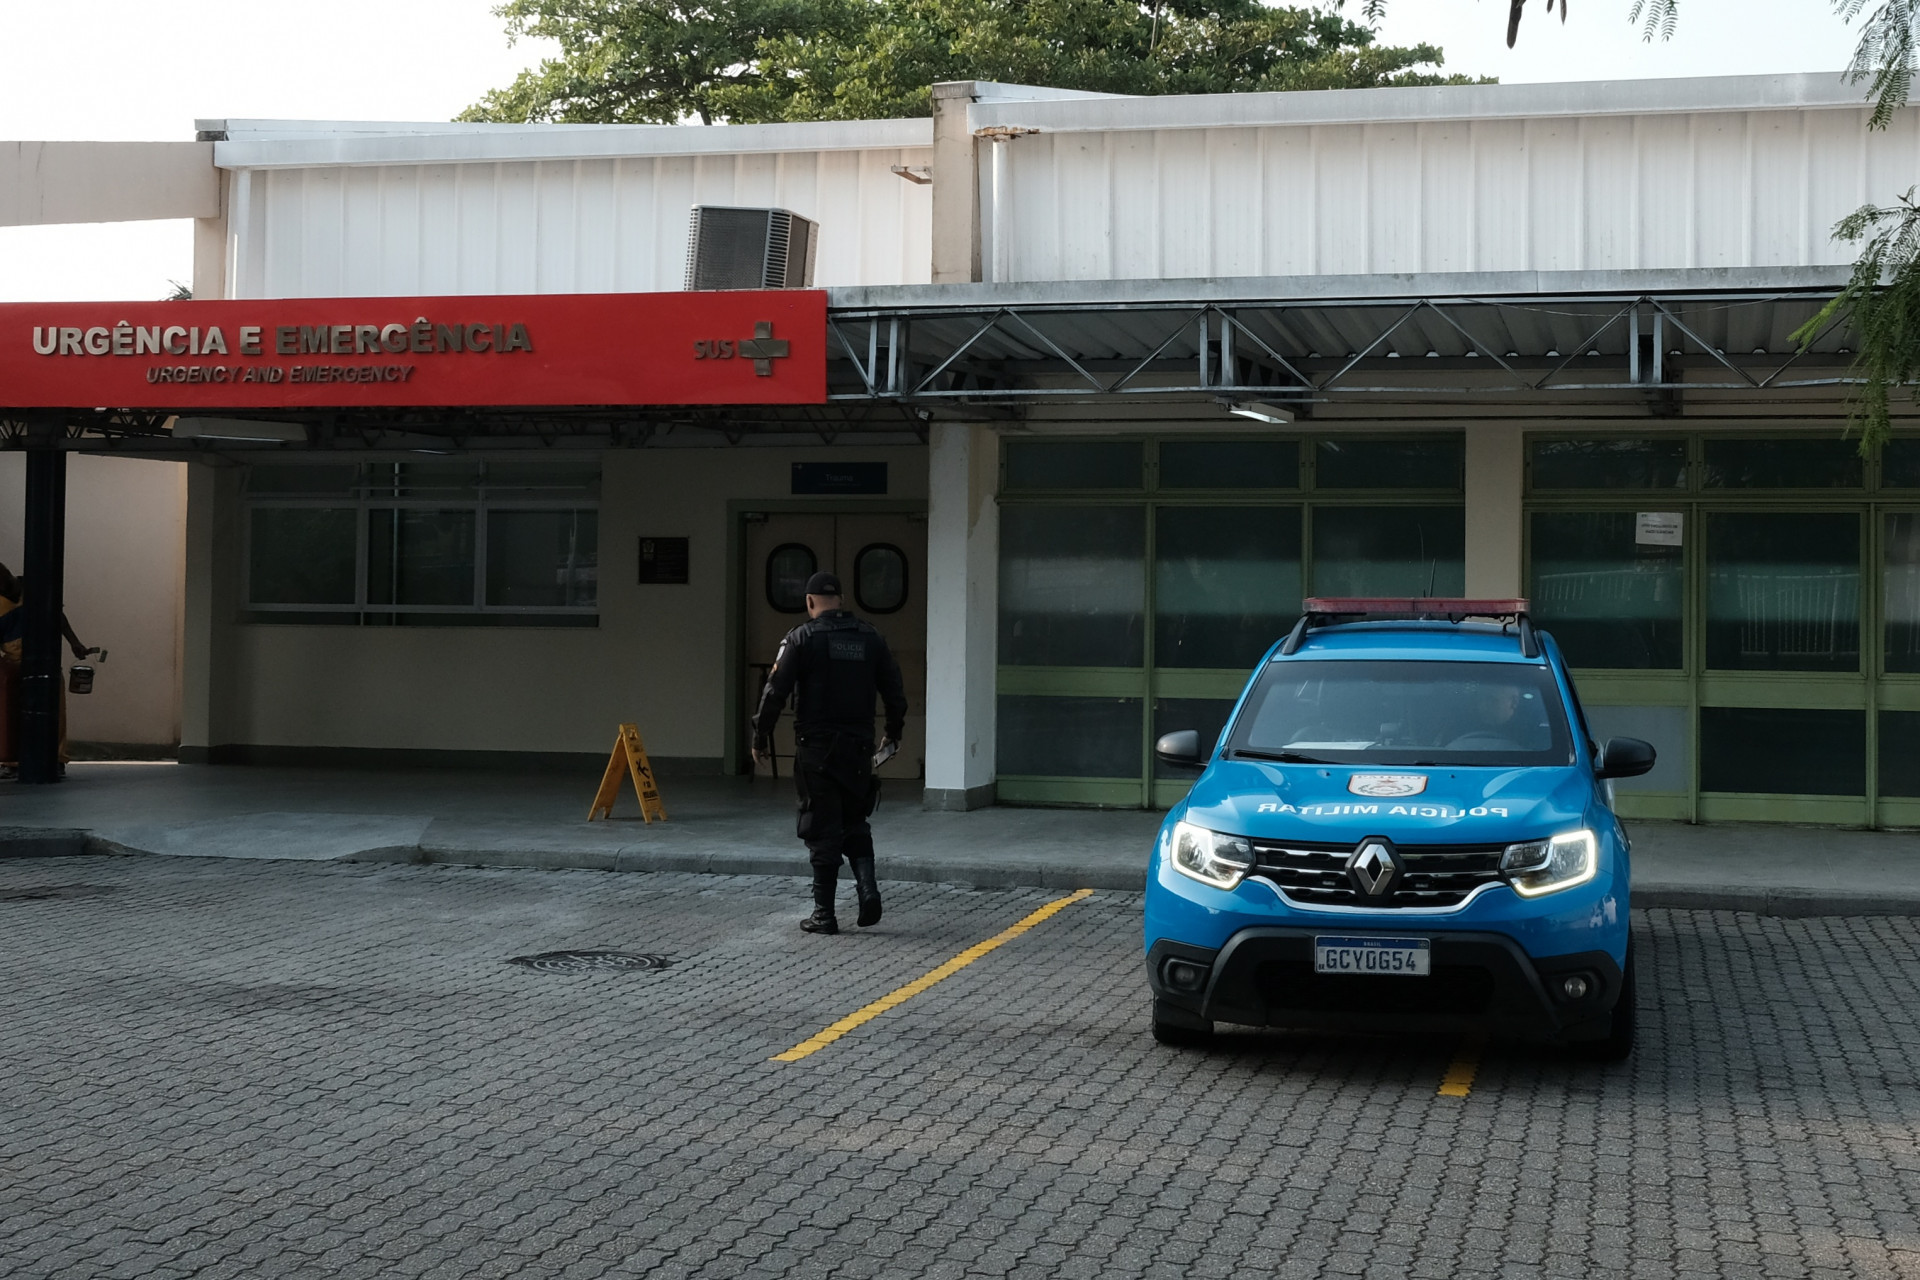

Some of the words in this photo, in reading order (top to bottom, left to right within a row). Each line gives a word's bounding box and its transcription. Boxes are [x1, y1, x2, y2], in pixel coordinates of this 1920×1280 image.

[33, 320, 228, 355] URGÊNCIA
[240, 327, 261, 354] E
[276, 317, 532, 354] EMERGÊNCIA
[694, 340, 734, 359] SUS
[146, 366, 240, 384] URGENCY
[243, 366, 283, 383] AND
[289, 365, 414, 383] EMERGENCY
